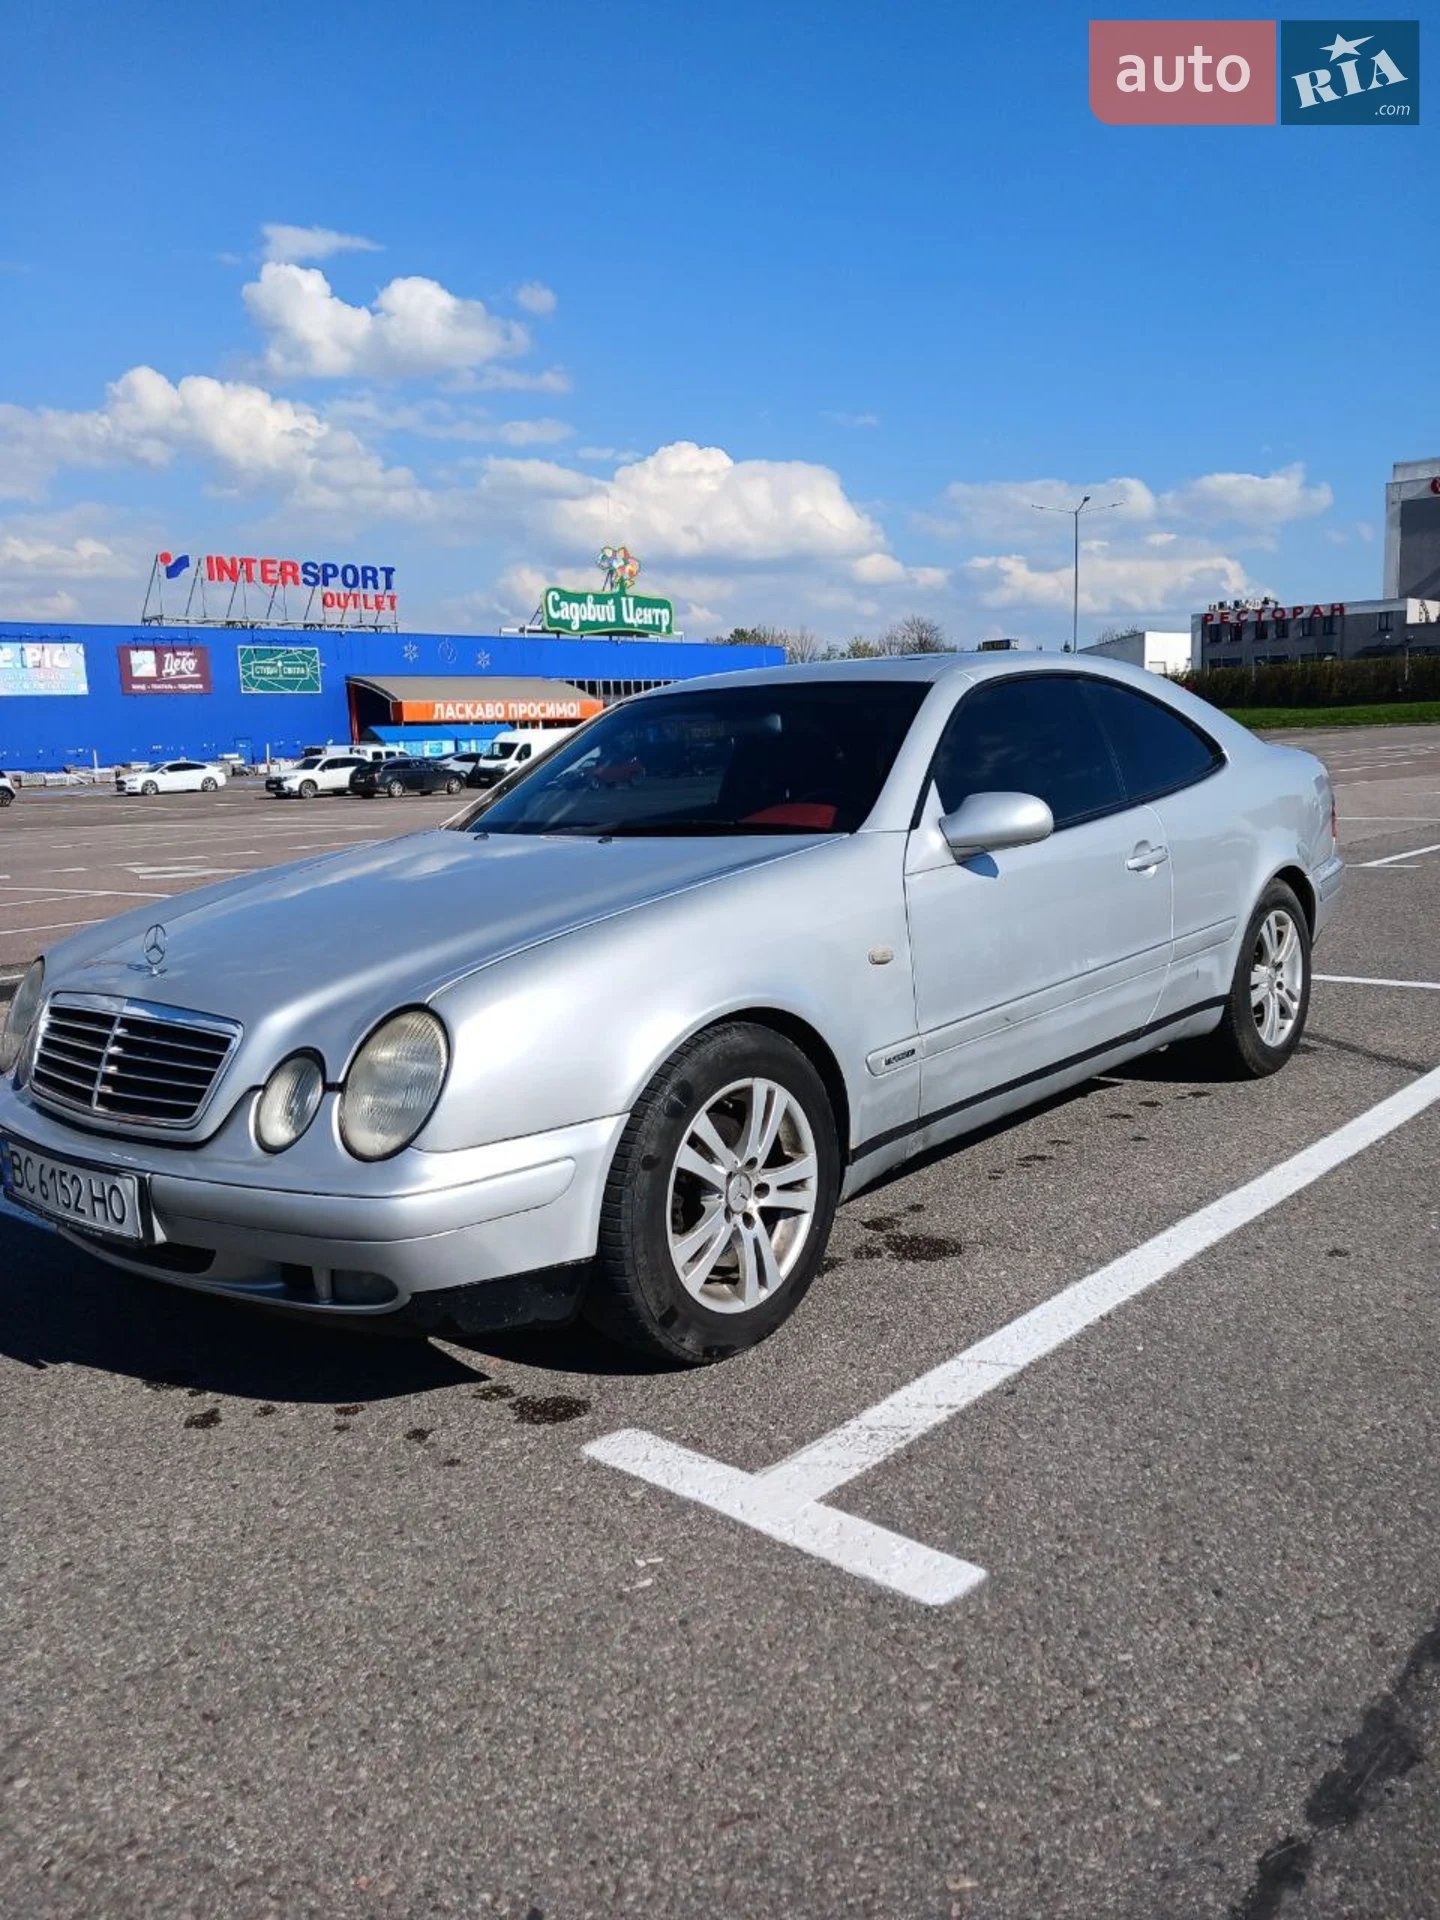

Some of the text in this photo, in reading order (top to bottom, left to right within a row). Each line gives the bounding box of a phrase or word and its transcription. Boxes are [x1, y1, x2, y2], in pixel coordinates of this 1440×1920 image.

[206, 555, 396, 590] INTERSPORT
[322, 591, 397, 611] OUTLET
[547, 591, 670, 633] Садовий Центр
[1202, 603, 1345, 625] РЕСТОРАН
[433, 701, 581, 720] ЛАСКАВО ПРОСИМО!
[10, 1150, 127, 1225] BC 6152 HO
